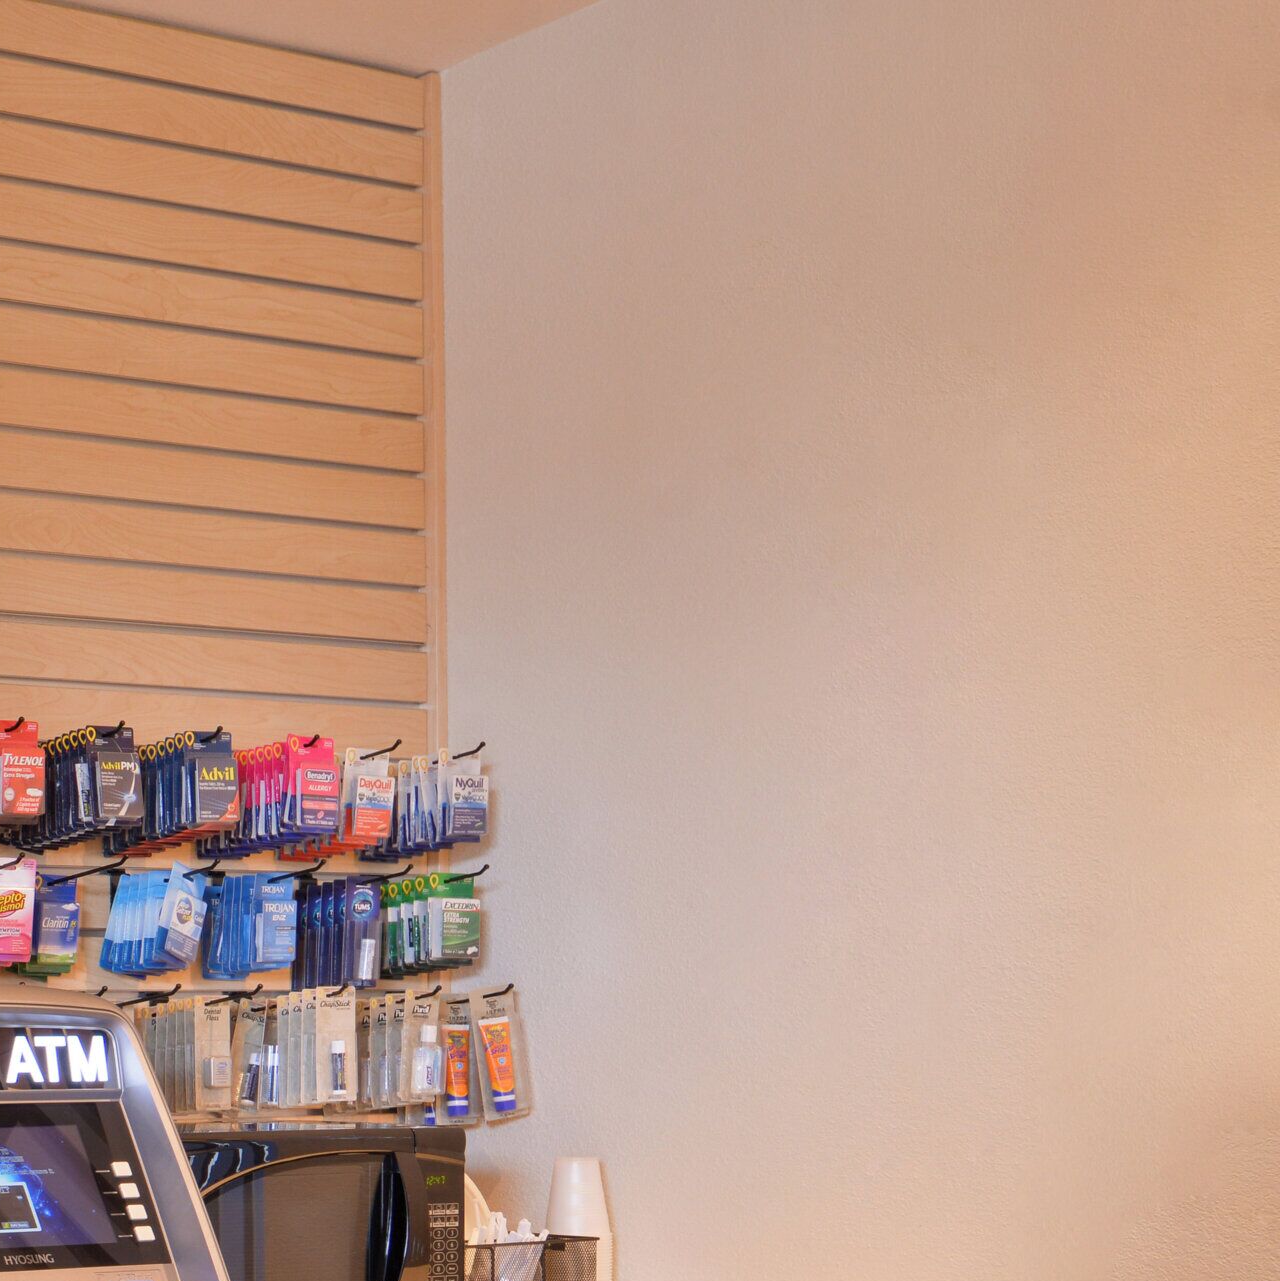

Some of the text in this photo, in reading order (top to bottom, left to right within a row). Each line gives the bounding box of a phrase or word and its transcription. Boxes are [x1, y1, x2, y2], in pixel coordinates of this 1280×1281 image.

[3, 752, 44, 767] TYLENOL
[199, 766, 236, 781] Advil
[306, 770, 334, 782] Benadryl
[359, 777, 392, 791] DayQuil
[454, 776, 484, 791] NyQuil
[260, 884, 286, 894] TROJAN
[264, 902, 296, 914] TROJAN
[353, 902, 372, 912] TUMS
[443, 900, 480, 911] EXCEDRIN
[41, 916, 69, 930] Claritin
[319, 999, 352, 1009] ChapStick
[203, 1008, 222, 1016] Dental
[5, 1034, 109, 1084] ATM
[3, 1253, 55, 1266] HYOSUNG
